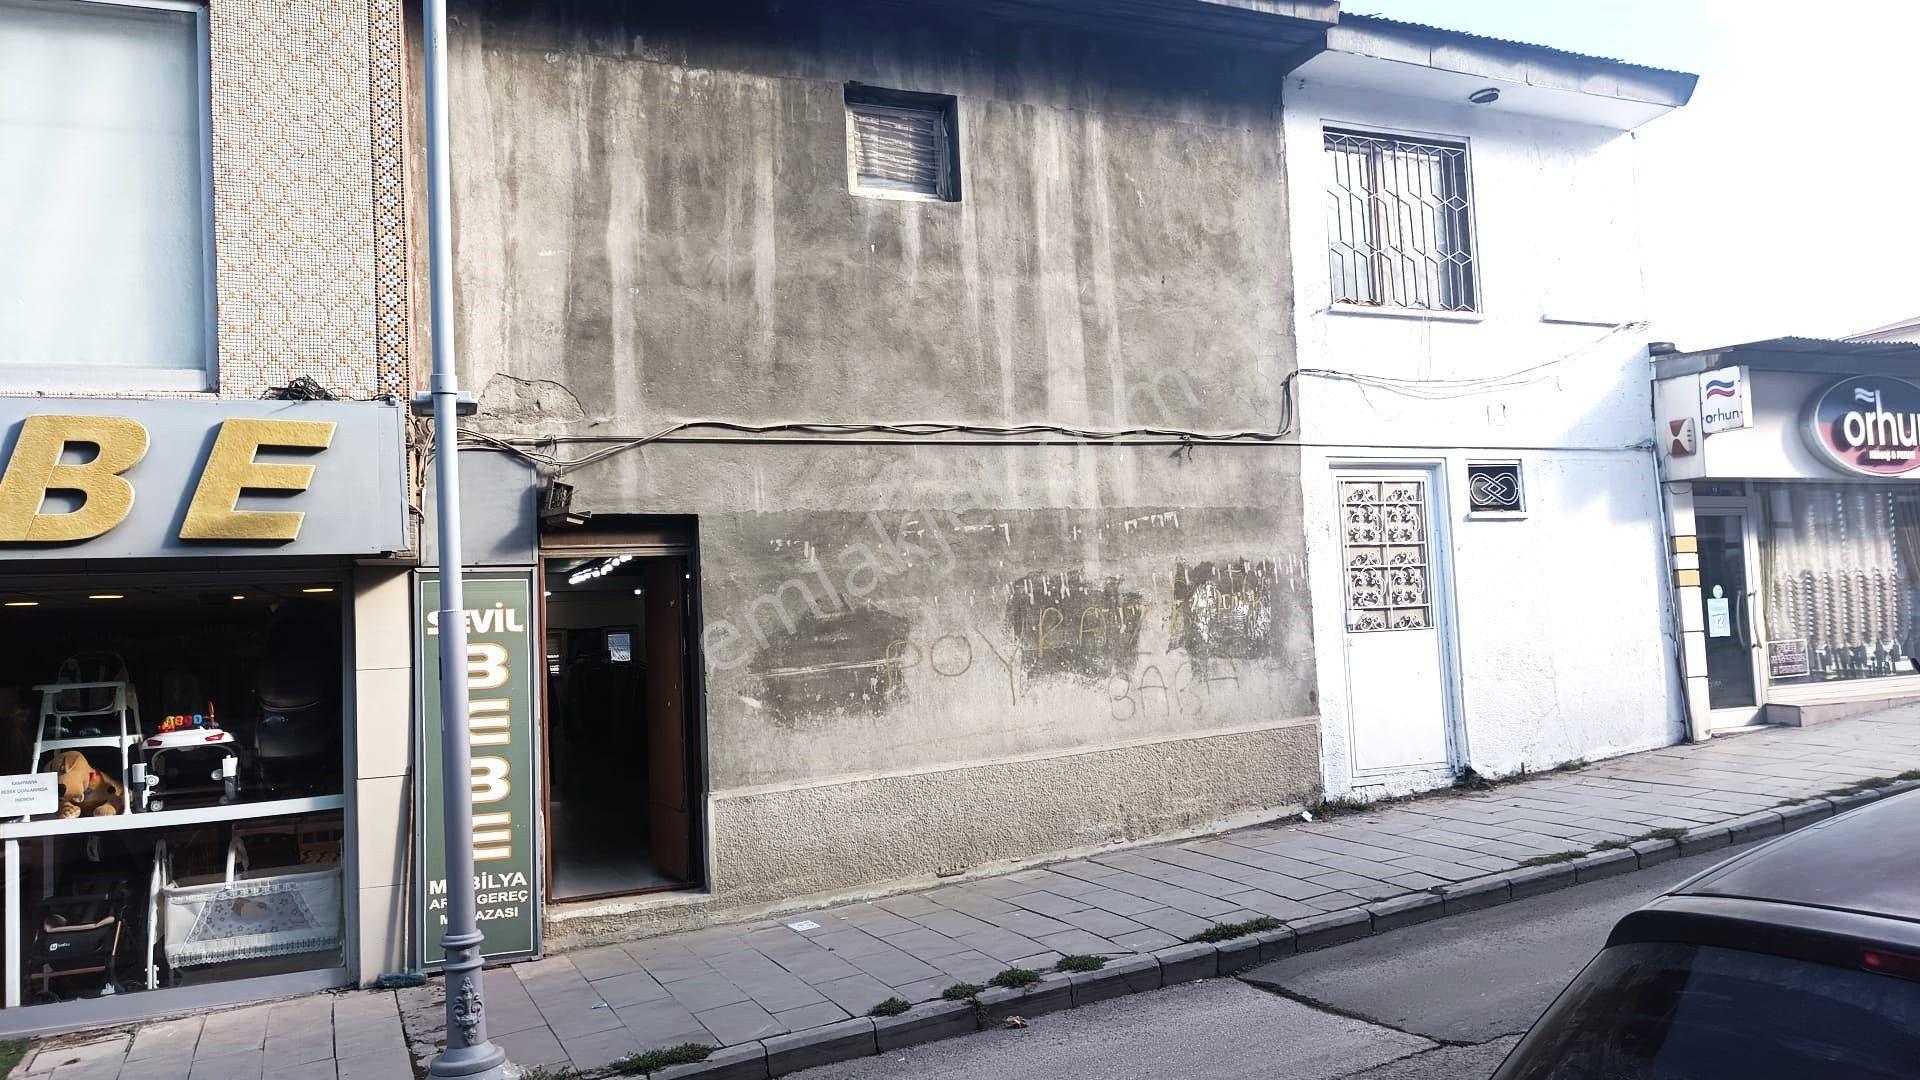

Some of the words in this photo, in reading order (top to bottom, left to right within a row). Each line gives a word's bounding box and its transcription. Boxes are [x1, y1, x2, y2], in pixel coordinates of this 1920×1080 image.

[1705, 407, 1740, 424] orhun
[1843, 389, 1920, 447] orhu
[427, 602, 525, 636] SVİL
[429, 872, 528, 895] MBİLYA
[476, 890, 529, 903] GEREÇ
